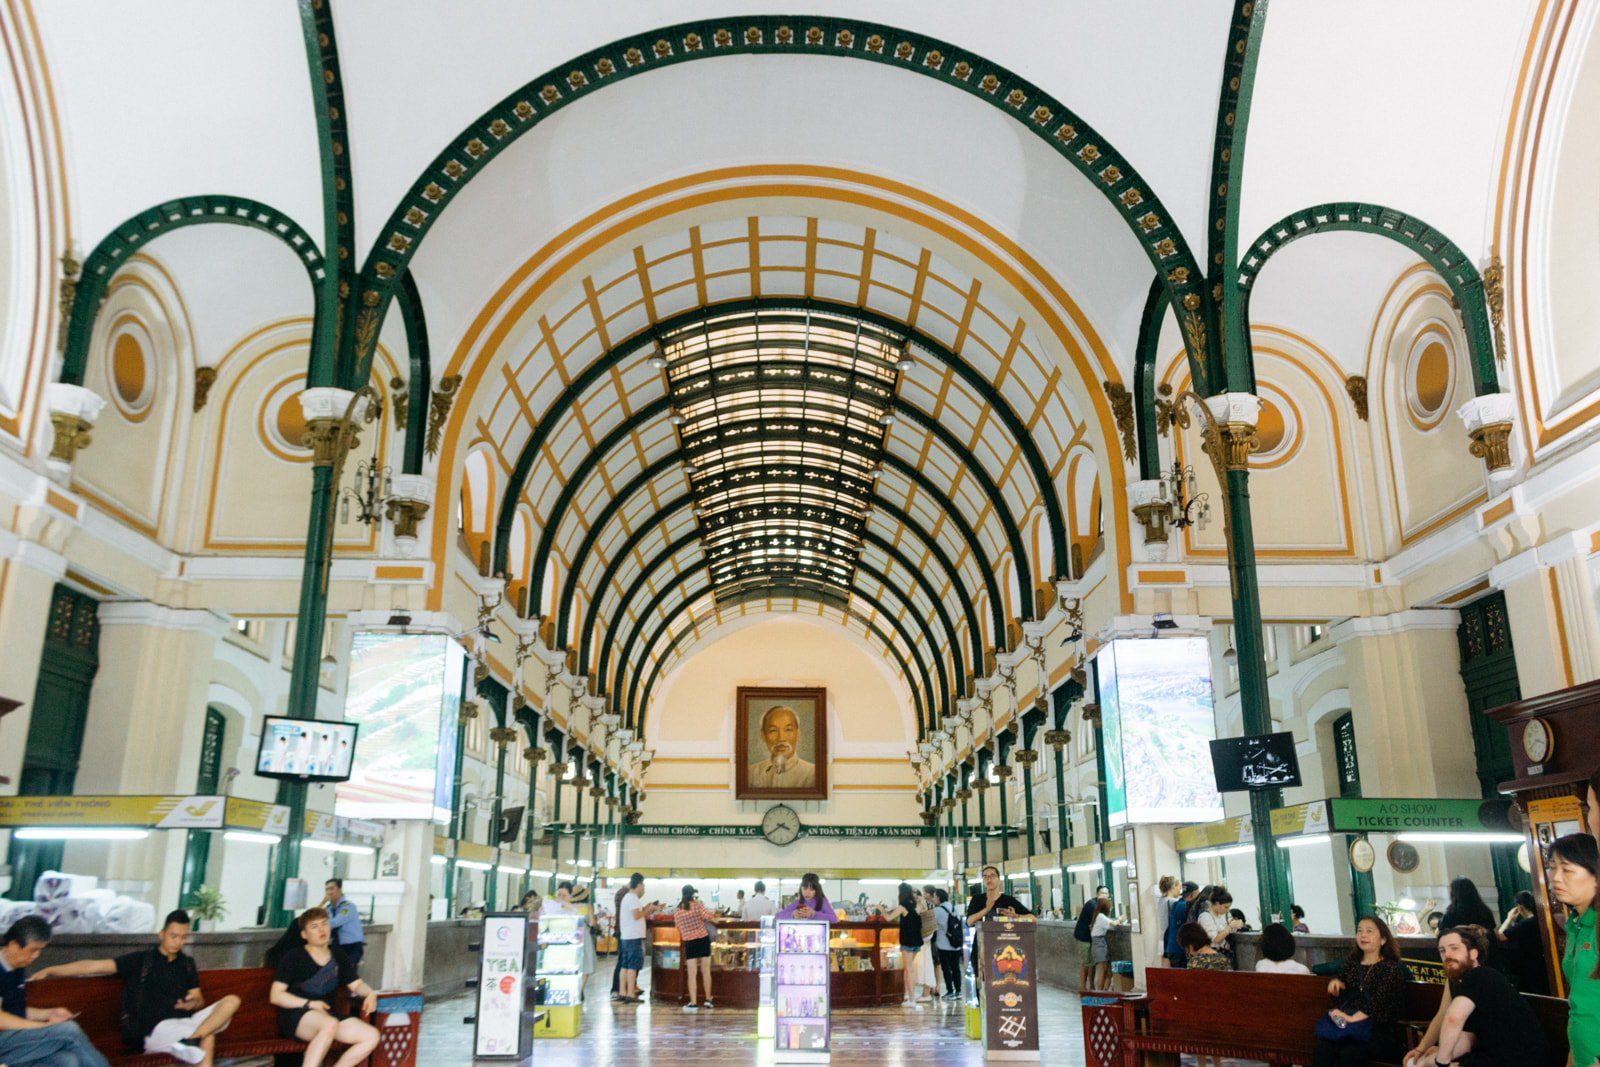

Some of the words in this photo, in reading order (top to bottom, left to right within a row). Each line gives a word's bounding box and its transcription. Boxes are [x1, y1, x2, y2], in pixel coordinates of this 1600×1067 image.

[1400, 803, 1437, 815] SHOW
[1356, 816, 1400, 826] TICKET
[1403, 816, 1464, 828] COUNTER
[671, 826, 700, 835] CHÓNG
[709, 826, 736, 835] CHÍNH
[738, 826, 756, 835] XÁC
[819, 827, 840, 835] TOÀN
[486, 957, 519, 972] TEA
[1420, 966, 1430, 975] AT
